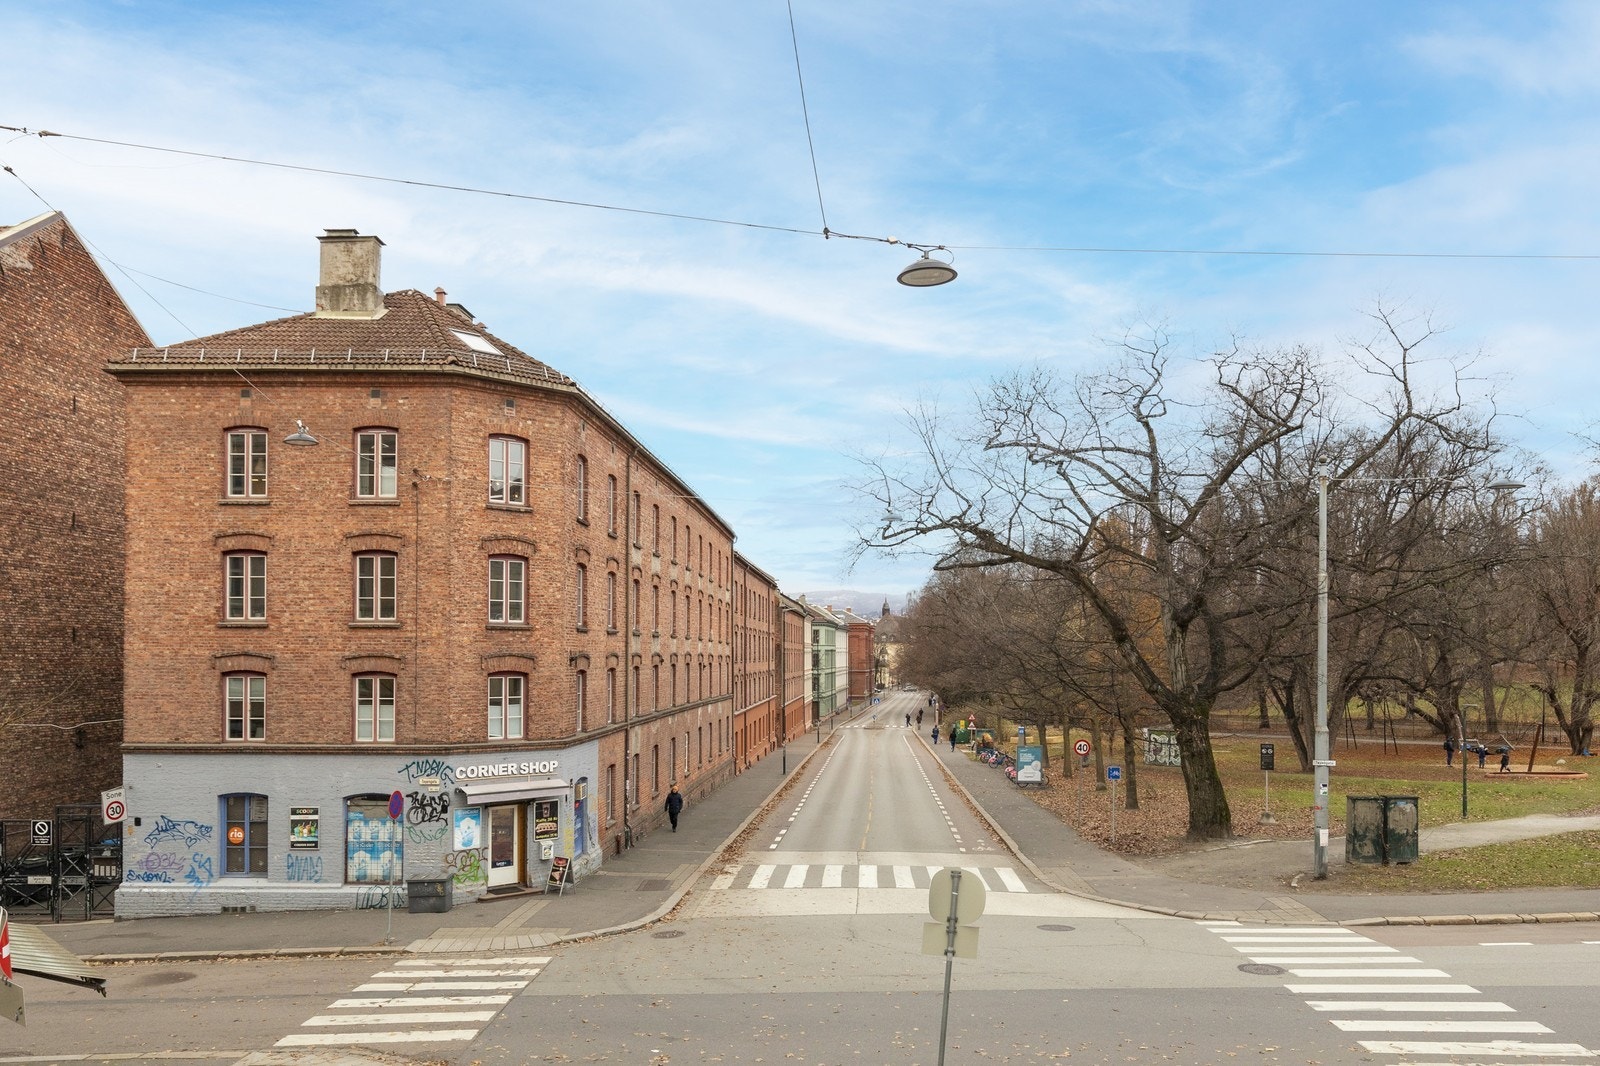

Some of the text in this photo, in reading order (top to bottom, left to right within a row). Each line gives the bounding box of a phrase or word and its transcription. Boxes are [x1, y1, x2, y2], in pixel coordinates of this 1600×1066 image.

[1076, 743, 1088, 752] 40
[455, 760, 559, 779] CORNER SHOP
[106, 791, 122, 800] Sone
[109, 805, 121, 816] 30
[229, 828, 243, 838] ria
